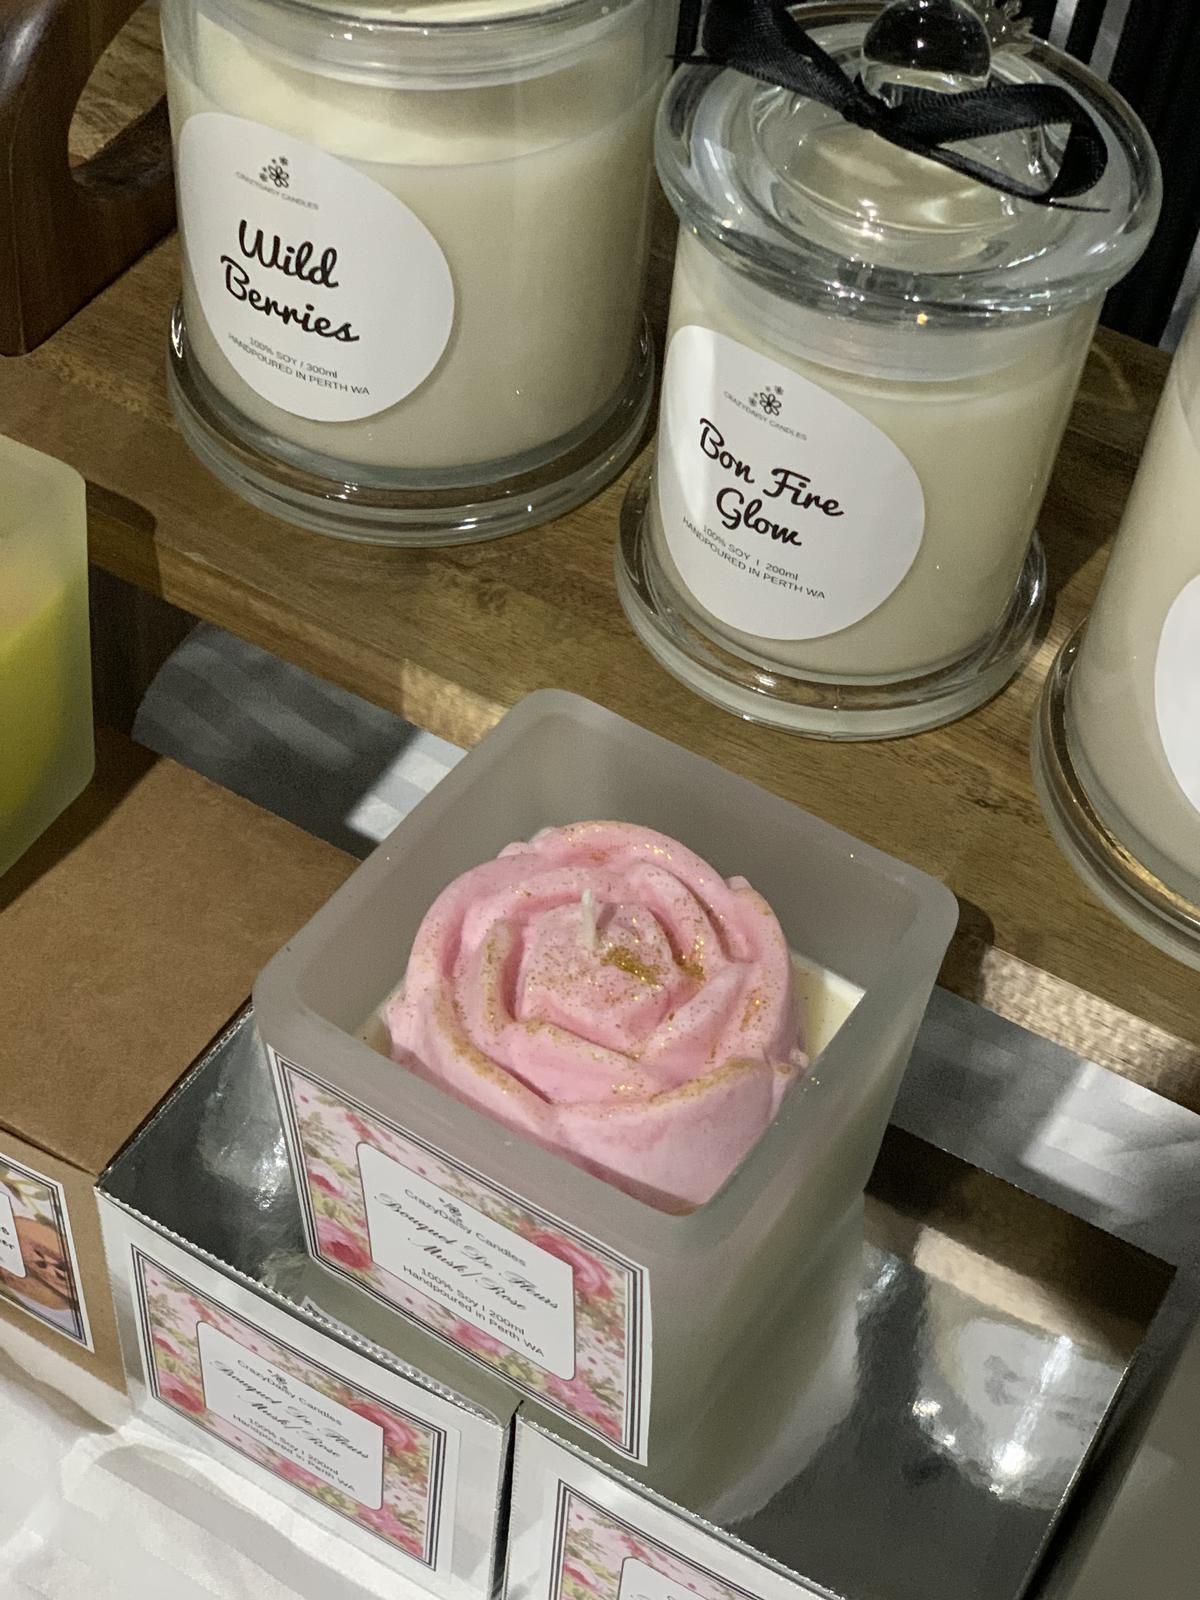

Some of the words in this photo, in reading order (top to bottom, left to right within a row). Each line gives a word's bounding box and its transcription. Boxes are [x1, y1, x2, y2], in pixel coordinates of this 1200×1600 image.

[238, 219, 339, 289] Wild
[220, 254, 360, 342] Berries
[228, 332, 293, 375] HANDPOURED
[295, 370, 306, 381] IN
[309, 375, 348, 392] PERTH
[350, 384, 370, 395] WA
[250, 336, 274, 355] 100%
[276, 350, 298, 366] SOY
[306, 363, 338, 378] 300ml
[700, 417, 755, 484] Bon
[762, 467, 844, 517] Fire
[716, 487, 802, 546] Glow
[683, 516, 746, 570] HANDPOURED
[748, 566, 760, 577] IN
[763, 572, 803, 593] PERTH
[805, 587, 825, 599] WA
[703, 525, 726, 547] 100%
[728, 543, 751, 560] SOY
[765, 562, 799, 581] 200ml
[374, 1192, 458, 1245] Bouquet
[460, 1245, 493, 1269] De
[498, 1270, 558, 1309] Fleurs
[475, 1232, 526, 1267] Candles
[403, 1264, 472, 1313] Handpoured
[475, 1311, 485, 1321] in
[489, 1318, 520, 1342] Perth
[523, 1339, 544, 1357] WA
[421, 1267, 453, 1292] 100%
[457, 1289, 479, 1308] Soy
[489, 1309, 524, 1335] 200ml
